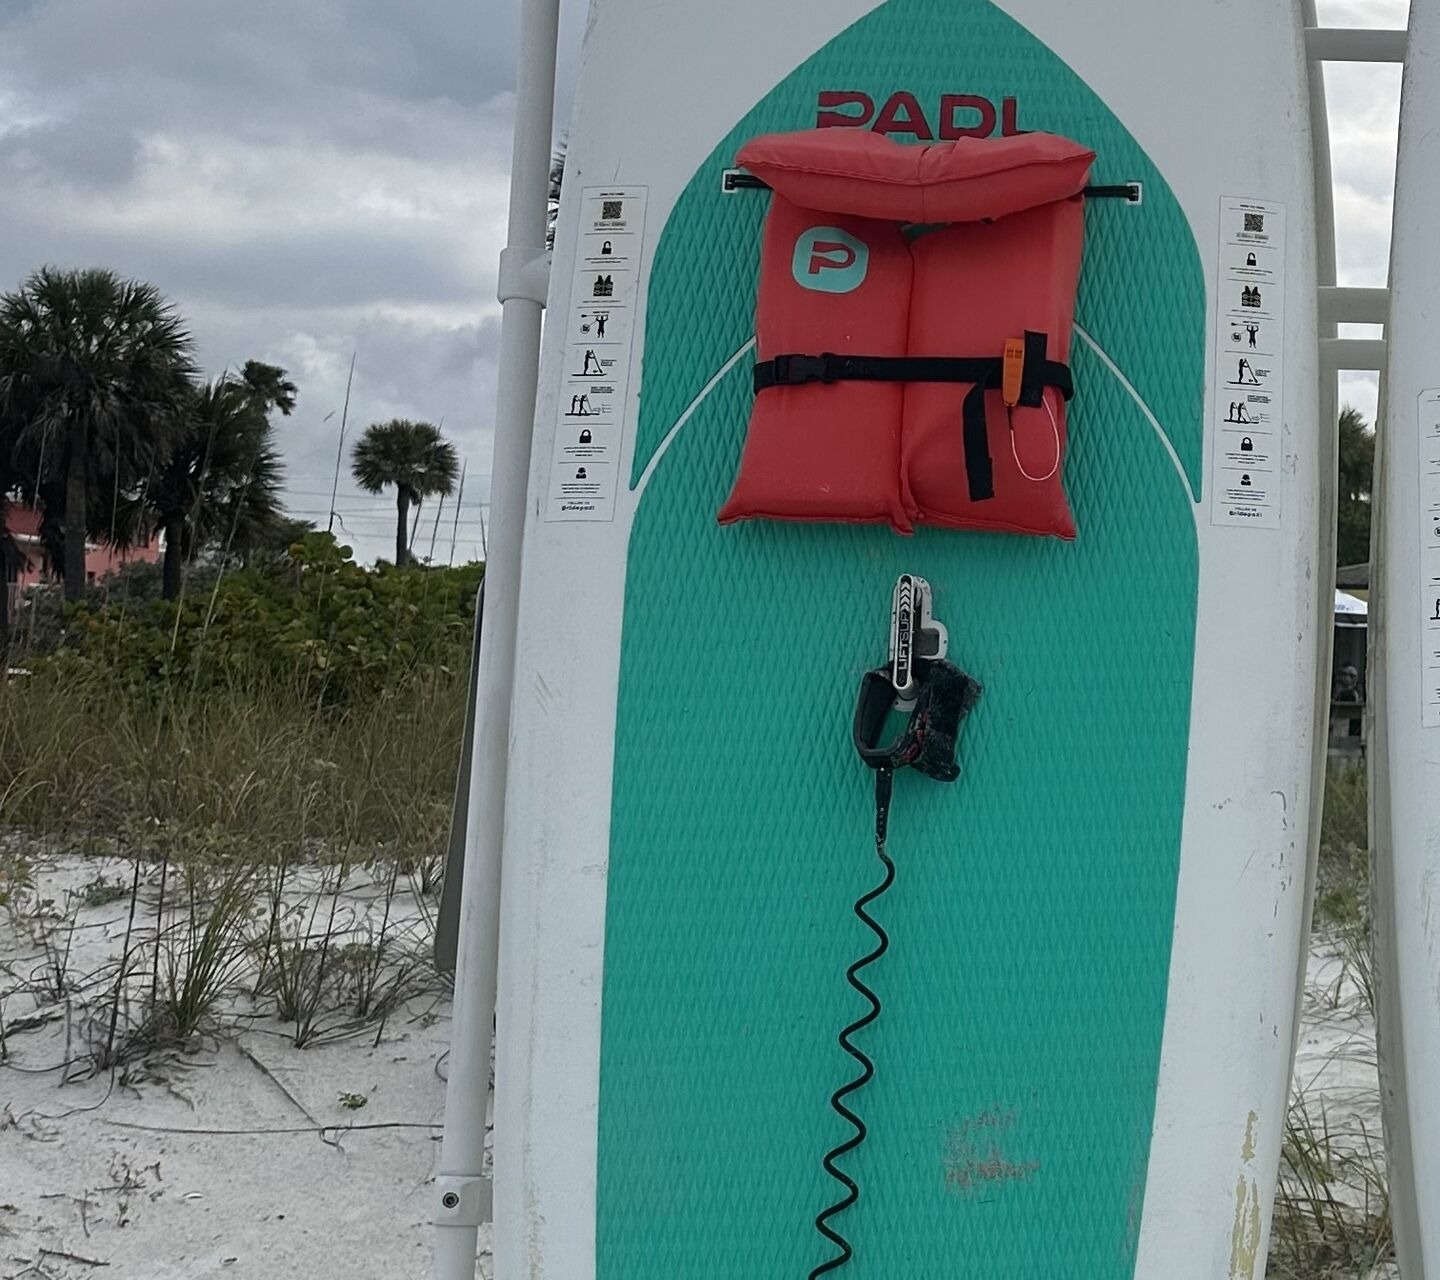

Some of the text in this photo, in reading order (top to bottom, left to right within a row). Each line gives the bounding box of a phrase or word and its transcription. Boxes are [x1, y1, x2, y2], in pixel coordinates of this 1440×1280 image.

[816, 90, 1055, 141] PADL
[808, 240, 856, 275] P
[898, 612, 910, 670] LIFTSUP
